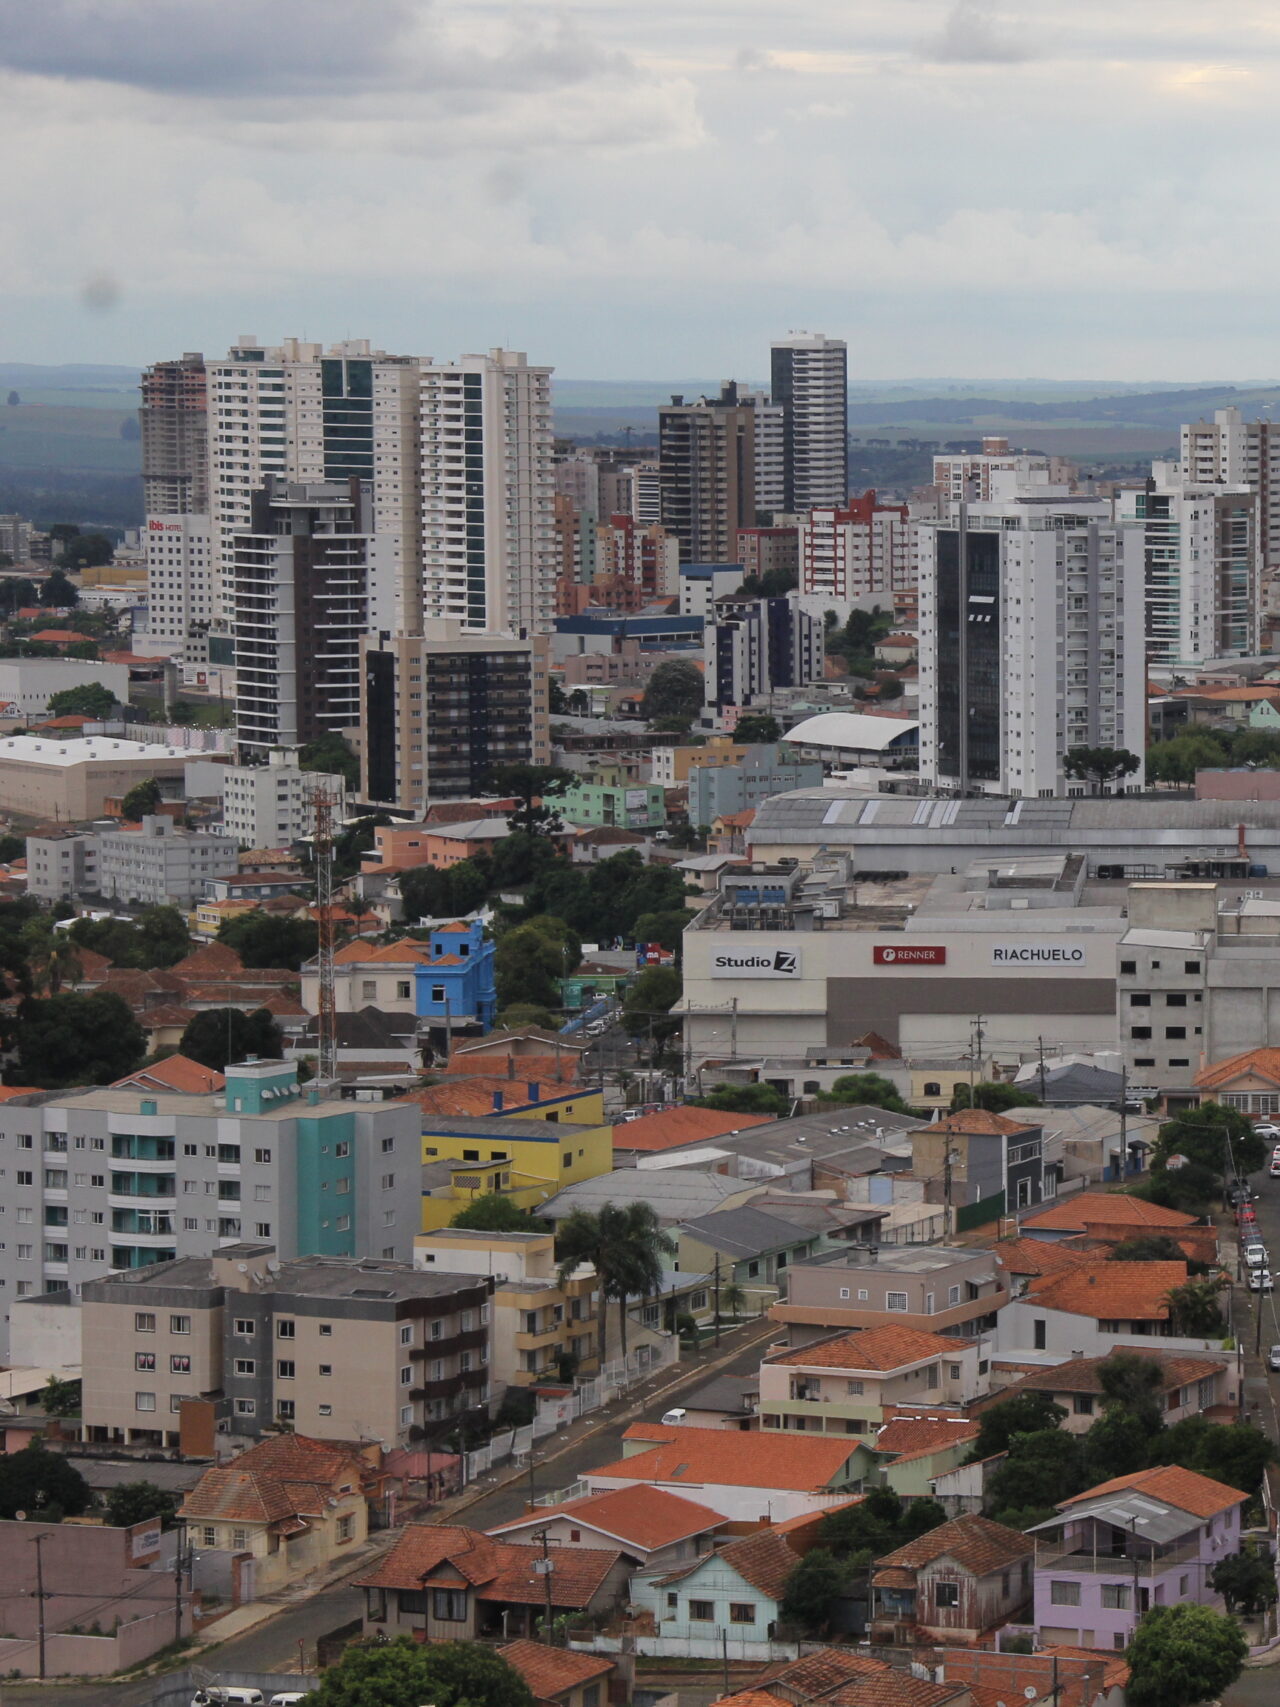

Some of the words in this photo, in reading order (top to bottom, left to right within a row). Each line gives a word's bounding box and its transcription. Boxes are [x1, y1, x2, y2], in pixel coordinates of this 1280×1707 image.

[149, 520, 164, 531] ibis
[898, 950, 935, 960] RENNER
[993, 948, 1082, 961] RIACHUELO
[715, 956, 771, 967] Studio
